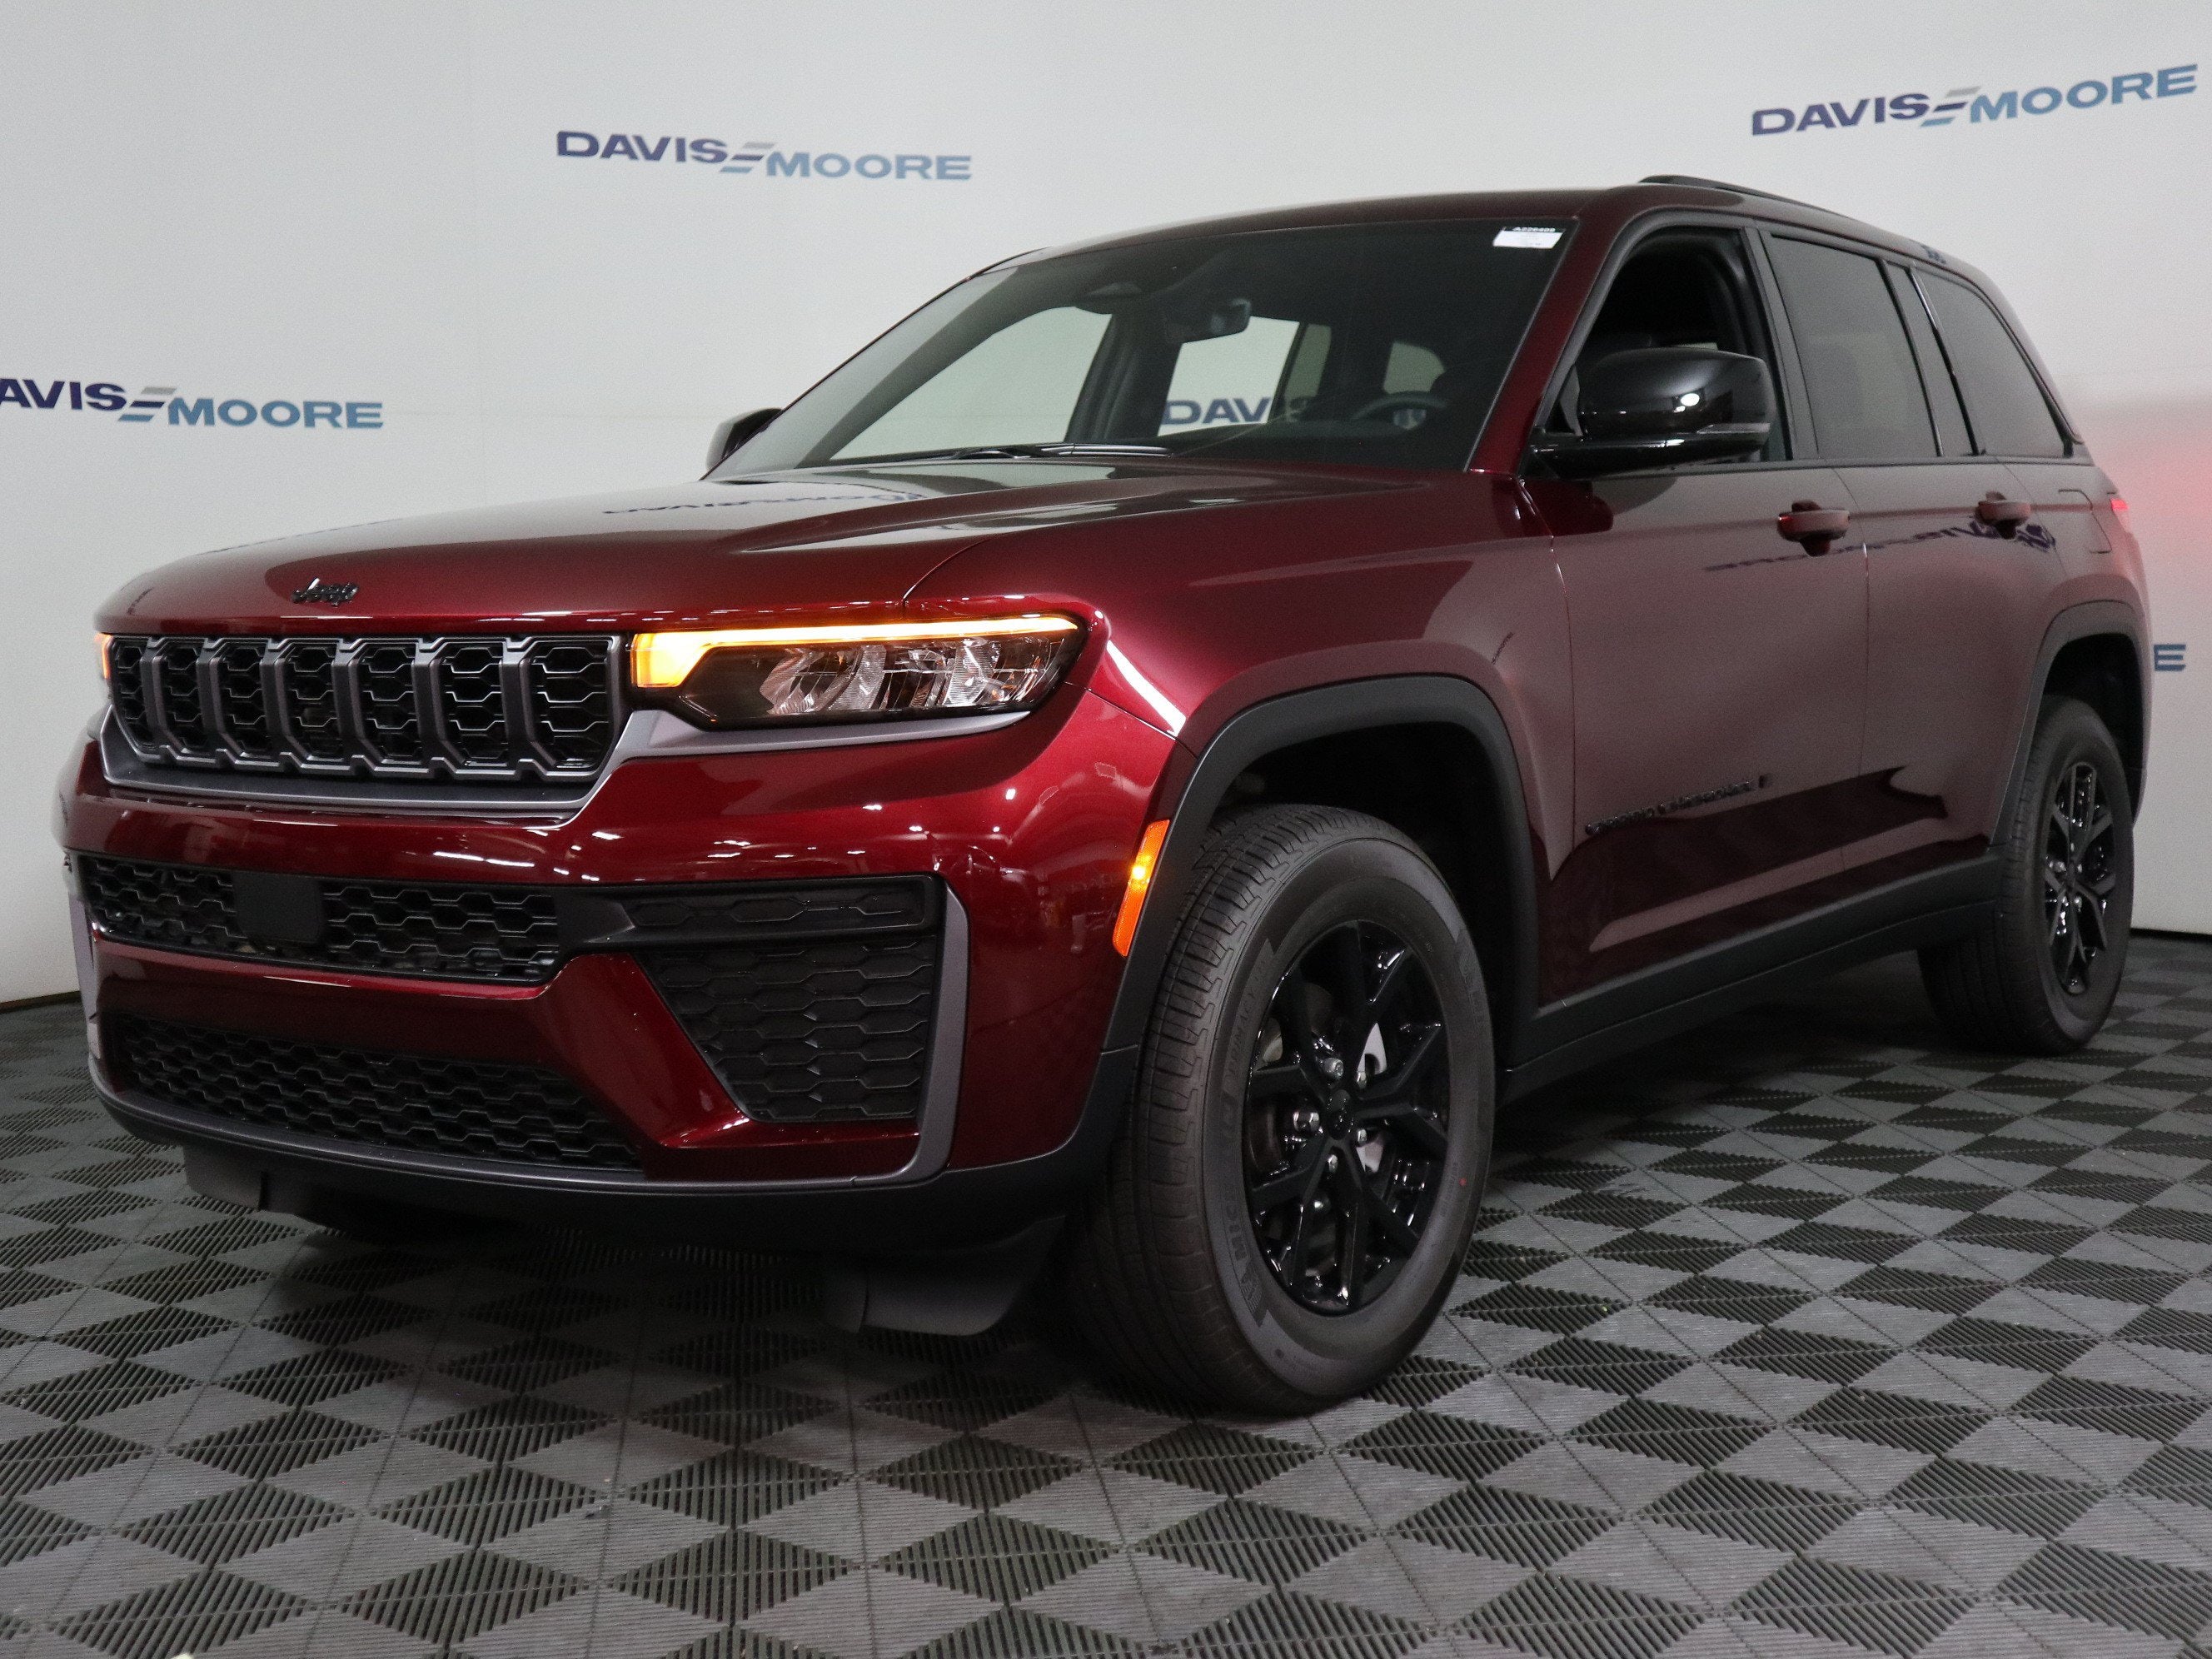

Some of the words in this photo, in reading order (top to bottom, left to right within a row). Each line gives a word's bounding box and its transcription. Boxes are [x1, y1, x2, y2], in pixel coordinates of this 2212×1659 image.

[1751, 92, 1930, 136] DAVIS
[1970, 63, 2199, 123] MOORE
[556, 131, 728, 164] DAVIS
[765, 151, 973, 181] MOORE
[0, 377, 127, 411] AVIS
[167, 396, 384, 429] MOORE
[1161, 396, 1271, 425] DAV
[291, 577, 360, 606] Jeep
